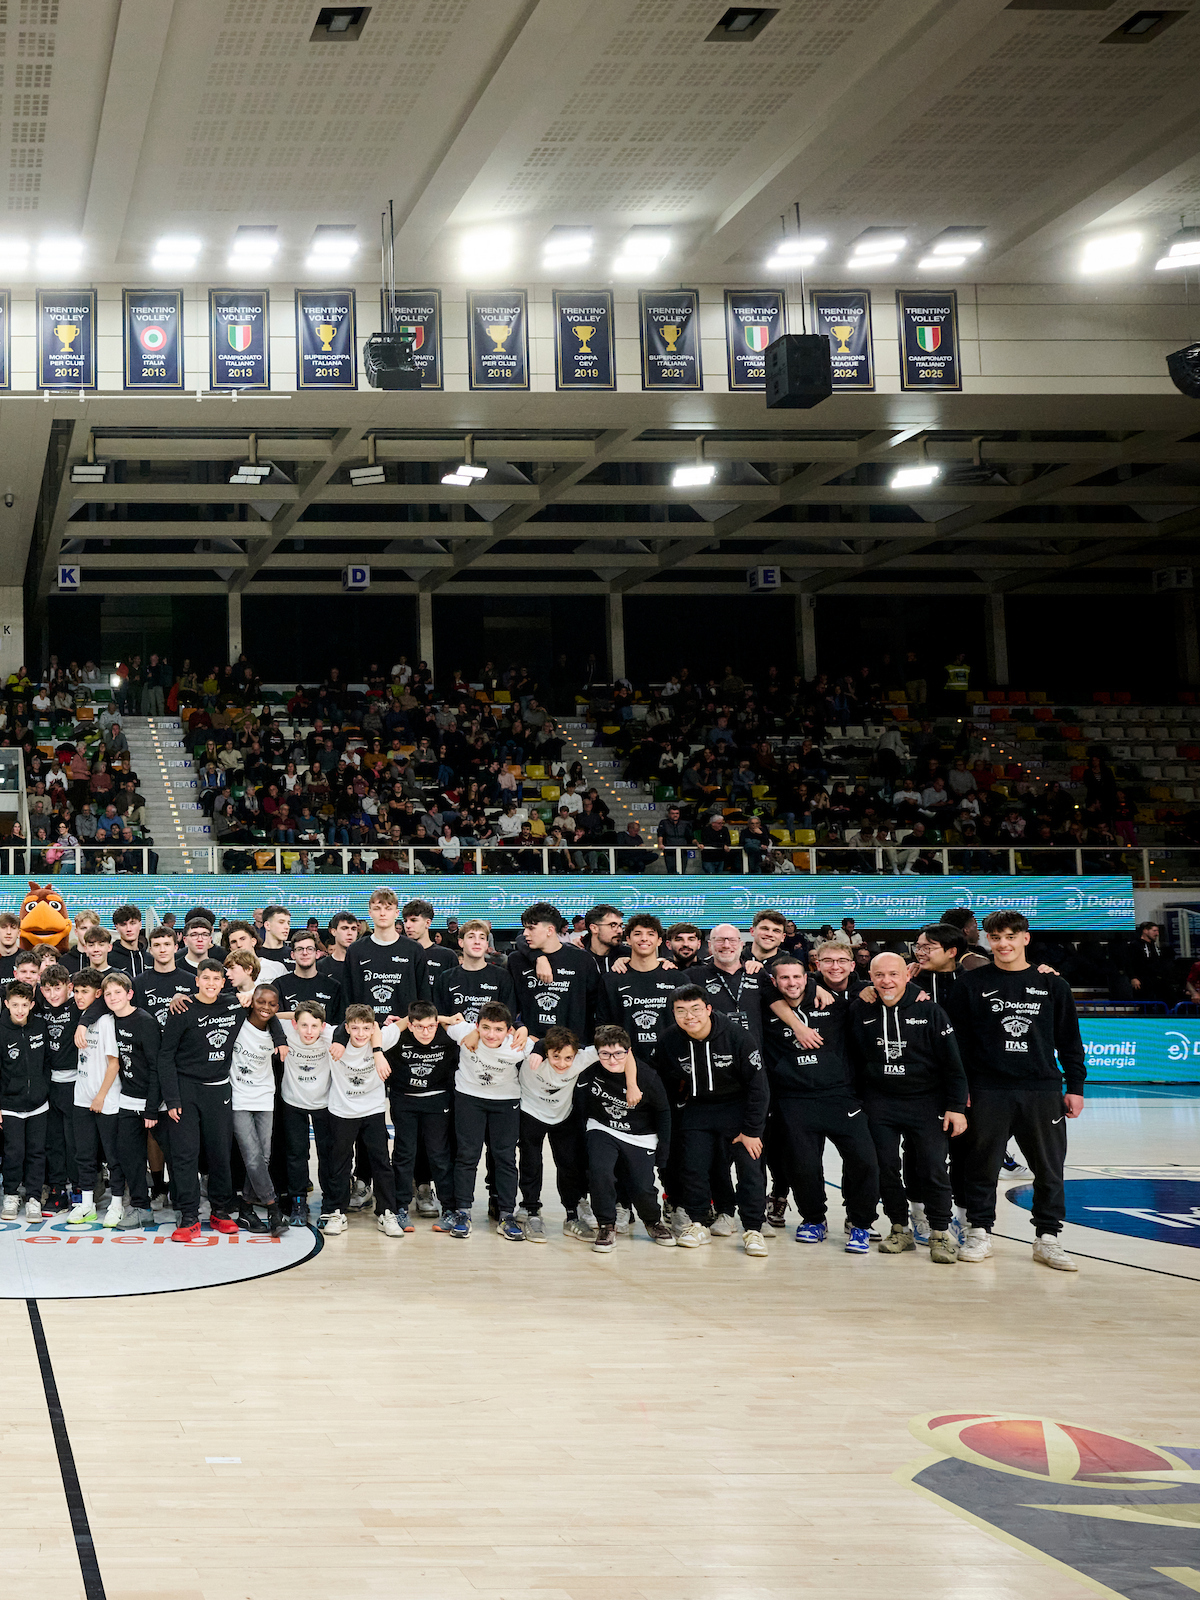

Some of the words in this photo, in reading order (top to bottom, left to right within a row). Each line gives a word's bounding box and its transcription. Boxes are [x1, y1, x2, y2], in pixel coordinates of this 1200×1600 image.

[49, 314, 84, 322] VOLLEY
[136, 314, 170, 322] VOLLEY
[222, 314, 256, 322] VOLLEY
[309, 314, 343, 322] VOLLEY
[55, 368, 79, 377] 2012
[142, 368, 166, 377] 2013
[228, 368, 252, 377] 2013
[315, 368, 339, 377] 2013
[487, 369, 511, 377] 2018
[574, 369, 598, 377] 2019
[661, 369, 685, 377] 2021
[833, 369, 858, 378] 2024
[918, 369, 942, 377] 2025
[61, 569, 76, 584] K
[352, 569, 366, 582] D
[764, 569, 775, 584] E
[3, 626, 11, 635] K
[643, 894, 705, 907] Dolomiti
[754, 895, 816, 907] Dolomiti
[865, 895, 927, 907] Dolomiti
[976, 895, 1039, 907] Dolomiti
[885, 907, 926, 917] energia
[634, 997, 667, 1005] Dolomiti
[1005, 1001, 1041, 1010] Dolomiti
[1087, 1056, 1136, 1068] energia
